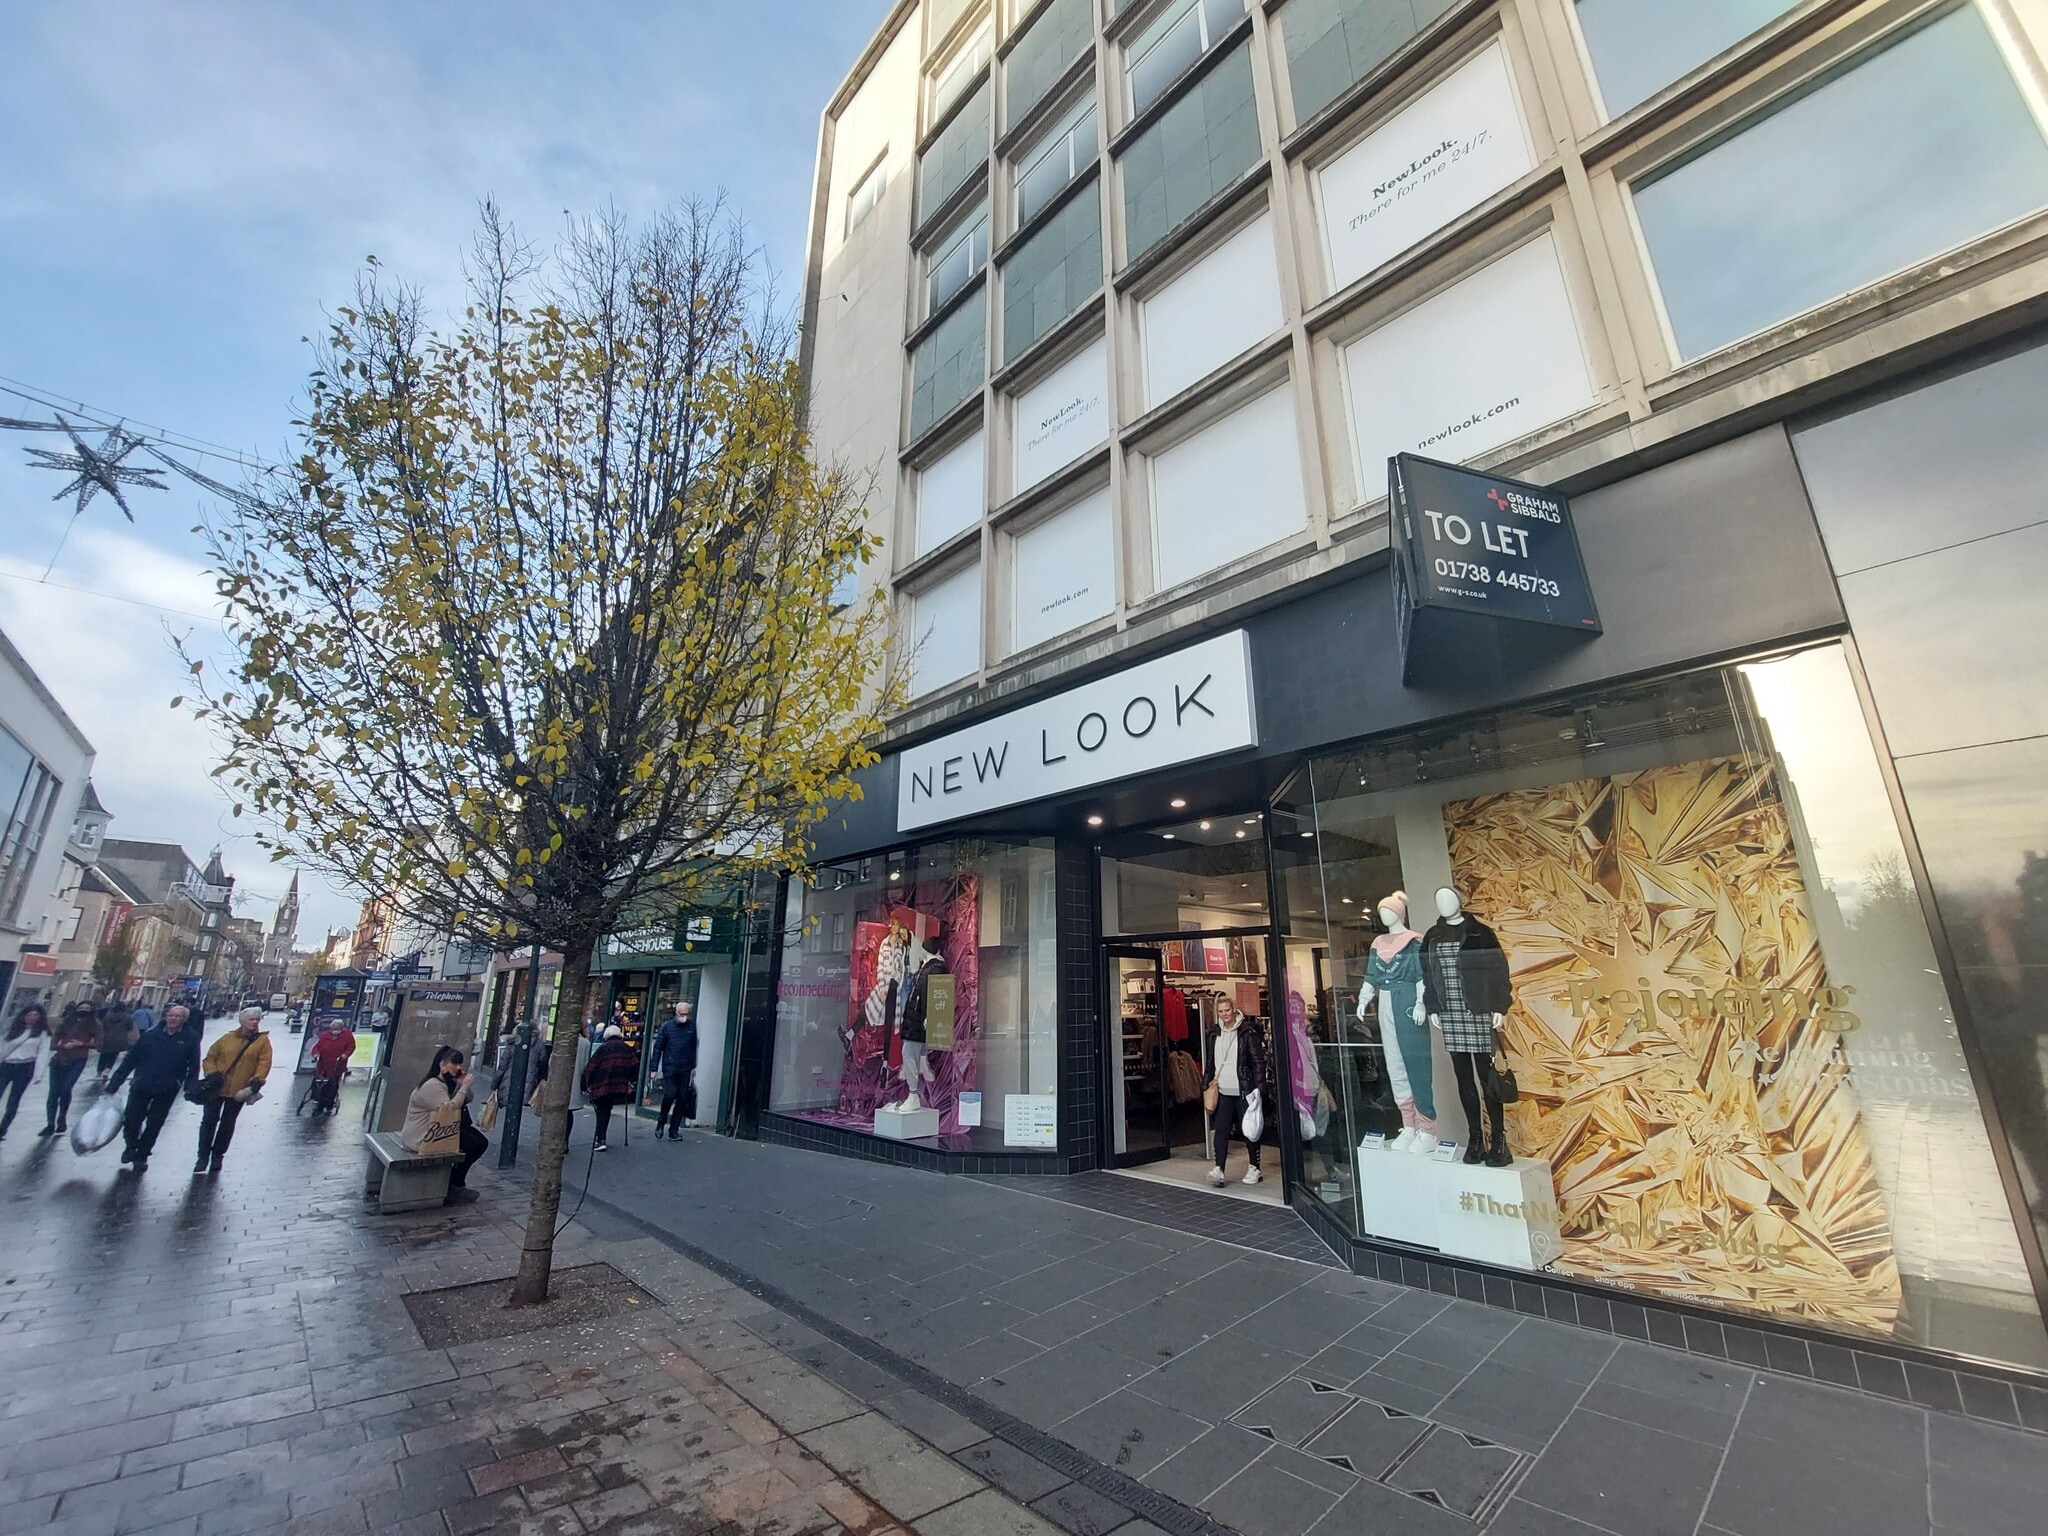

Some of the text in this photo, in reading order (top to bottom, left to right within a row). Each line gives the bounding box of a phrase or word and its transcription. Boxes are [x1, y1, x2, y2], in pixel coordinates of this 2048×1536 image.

[1348, 129, 1493, 231] There for me 24/7.
[1372, 139, 1458, 200] NewLook.
[1041, 397, 1084, 431] NewLook.
[1417, 397, 1520, 450] newlook.com
[1027, 432, 1050, 451] There
[1051, 423, 1063, 435] for
[1064, 414, 1077, 426] me
[1506, 492, 1559, 514] GRAHAM
[1510, 503, 1561, 524] SIBBALD
[1424, 509, 1529, 558] TO LET
[1434, 558, 1560, 597] 01738 445733
[1041, 587, 1089, 614] newlook.com
[911, 673, 1215, 803] NEW LOOK
[1566, 976, 1861, 1033] Rejoicing
[1791, 1066, 1970, 1096] hristmas
[422, 1120, 460, 1143] Boot
[1544, 1265, 1575, 1278] Collect
[1594, 1275, 1635, 1290] Shop app
[1660, 1289, 1724, 1307] newlook.com
